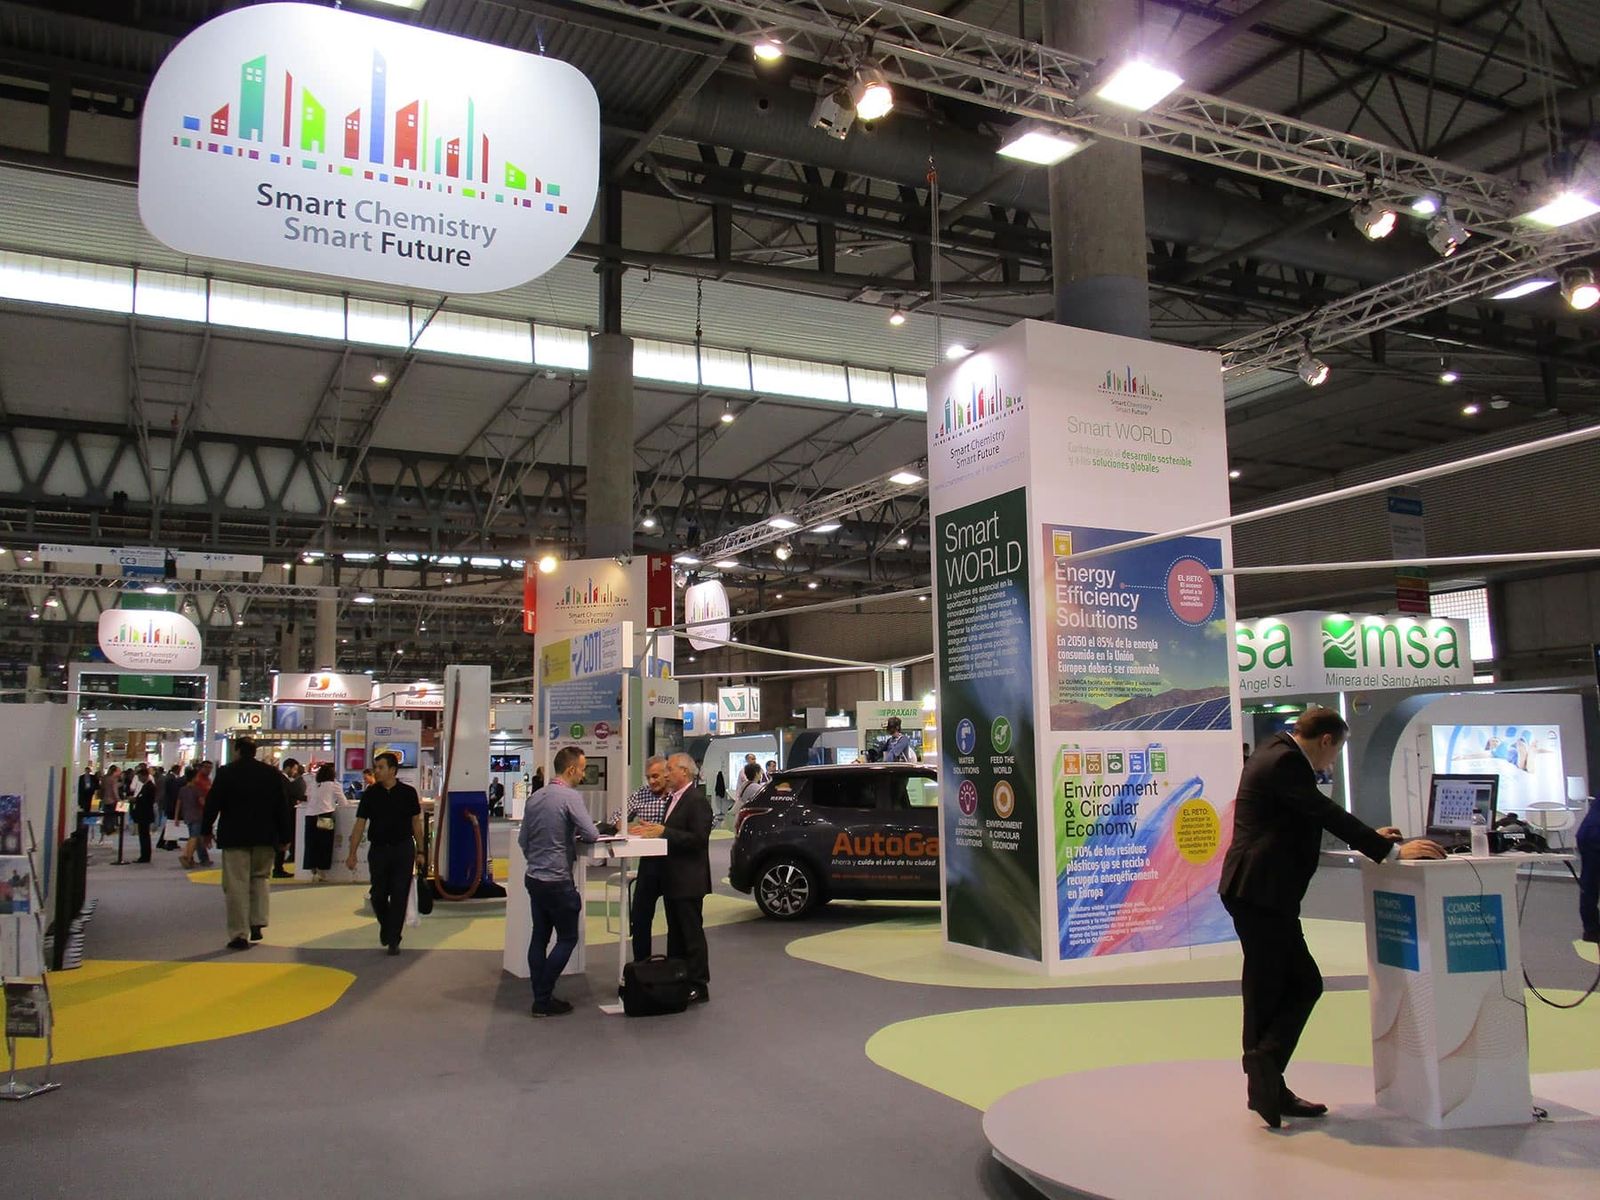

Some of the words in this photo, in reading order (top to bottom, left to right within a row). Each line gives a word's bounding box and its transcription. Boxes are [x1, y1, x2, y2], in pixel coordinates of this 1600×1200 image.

[256, 183, 347, 219] Smart
[354, 199, 498, 248] Chemistry
[284, 216, 373, 252] Smart
[381, 231, 472, 267] Future
[1128, 401, 1152, 411] Chemistry
[1067, 416, 1112, 438] Smart
[1115, 422, 1172, 446] WORLD
[950, 444, 970, 460] Smart
[970, 430, 1006, 450] Chemistry
[956, 454, 976, 469] Smart
[977, 445, 1000, 460] Future
[1092, 458, 1129, 470] soluciones
[1130, 462, 1159, 473] globales
[1122, 450, 1156, 462] desarrollo
[1158, 454, 1192, 467] sostenible
[945, 511, 1000, 552] Smart
[119, 556, 137, 564] CC3
[945, 540, 1022, 587] WORLD
[1055, 561, 1116, 588] Energy
[979, 582, 999, 592] esencial
[1055, 584, 1140, 616] Efficiency
[1056, 608, 1138, 630] Solutions
[583, 630, 601, 674] CDTI
[1057, 635, 1066, 646] En
[1068, 636, 1087, 647] 2050
[1089, 636, 1095, 648] el
[1096, 637, 1114, 648] 85%
[1115, 638, 1124, 649] de
[1126, 638, 1132, 649] la
[1133, 638, 1158, 653] energía
[1236, 623, 1293, 672] sa
[1360, 623, 1460, 669] msa
[145, 651, 178, 659] Chemistry
[1058, 649, 1094, 660] consumida
[1096, 651, 1105, 661] en
[1107, 650, 1113, 661] la
[1115, 650, 1134, 662] Unión
[1058, 662, 1087, 675] Europea
[1089, 663, 1112, 674] deberá
[1114, 665, 1125, 674] ser
[1126, 664, 1160, 675] renovable
[1239, 676, 1270, 694] Angel
[1274, 675, 1296, 689] S.L.
[1326, 673, 1362, 686] Minera
[1364, 674, 1379, 686] del
[1382, 674, 1411, 687] Santo
[305, 691, 348, 699] Biesterfeld
[239, 712, 260, 724] Mo
[953, 767, 980, 775] SOLUTIONS
[993, 767, 1013, 775] WORLD
[1064, 780, 1158, 798] Environment
[1065, 801, 1075, 818] &
[1080, 800, 1139, 817] Circular
[955, 829, 982, 837] EFFICIENCY
[986, 820, 1023, 830] ENVIRONMENT
[1066, 820, 1137, 838] Economy
[956, 839, 983, 848] SOLUTIONS
[993, 831, 1020, 840] CIRCULAR
[832, 832, 940, 857] AutoGa
[992, 841, 1019, 851] ECONOMY
[1066, 846, 1073, 858] El
[1074, 846, 1092, 857] 70%
[1094, 846, 1103, 856] de
[1105, 845, 1116, 856] los
[1117, 844, 1147, 855] residuos
[1066, 860, 1099, 875] plásticos
[1101, 861, 1111, 872] ya
[1112, 860, 1121, 869] se
[1122, 857, 1145, 868] recicla
[1145, 859, 1150, 867] o
[1067, 874, 1099, 887] recupera
[1101, 869, 1158, 885] energéticamente
[1068, 890, 1077, 899] en
[1078, 886, 1104, 900] Europa
[1447, 902, 1480, 913] COMOS
